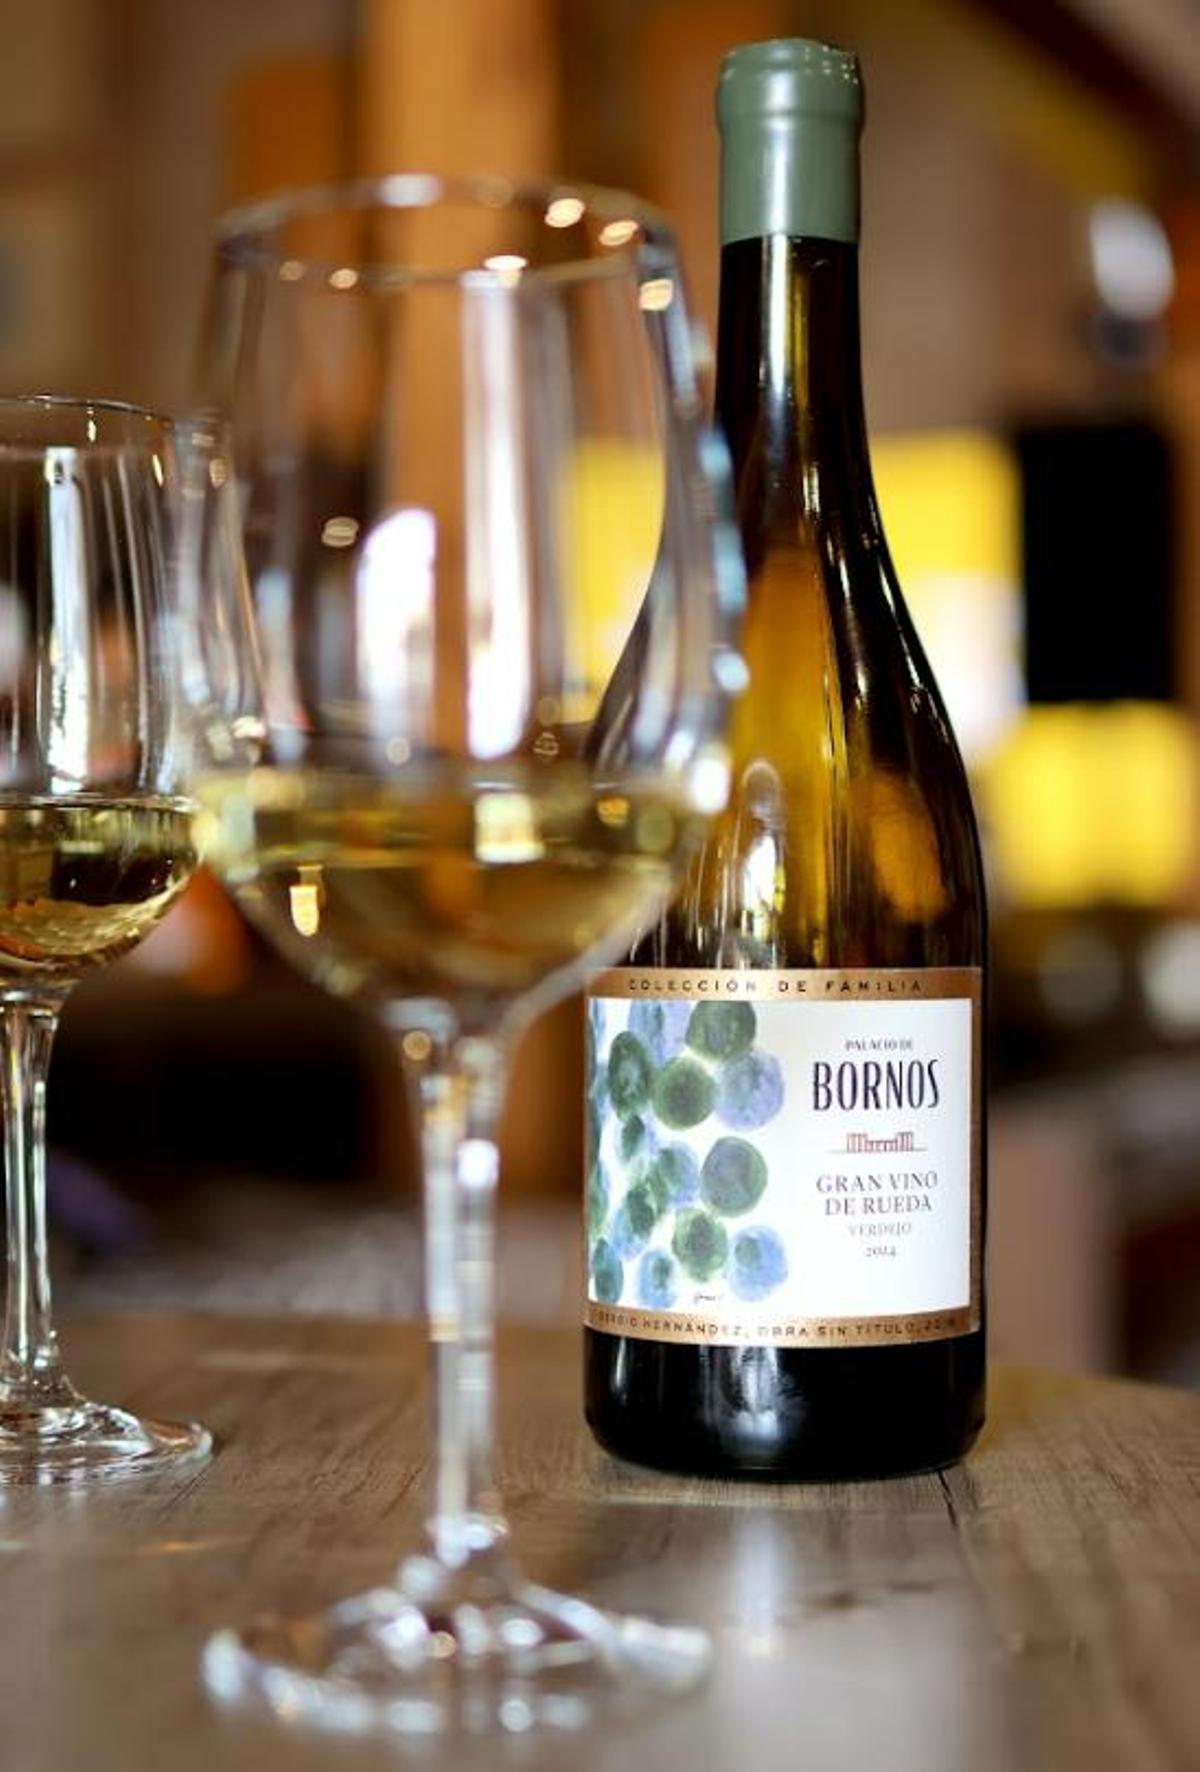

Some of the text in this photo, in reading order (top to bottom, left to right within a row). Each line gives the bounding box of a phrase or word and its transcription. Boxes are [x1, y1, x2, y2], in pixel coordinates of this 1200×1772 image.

[778, 979, 807, 993] DE
[825, 980, 922, 993] FAMILIA
[845, 1038, 913, 1051] PALACIO DE
[812, 1059, 940, 1111] BORNOS
[816, 1170, 938, 1195] GRAN VINO
[824, 1194, 932, 1216] DE RUEDA
[757, 1326, 808, 1337] OBRA
[817, 1325, 847, 1337] SIN
